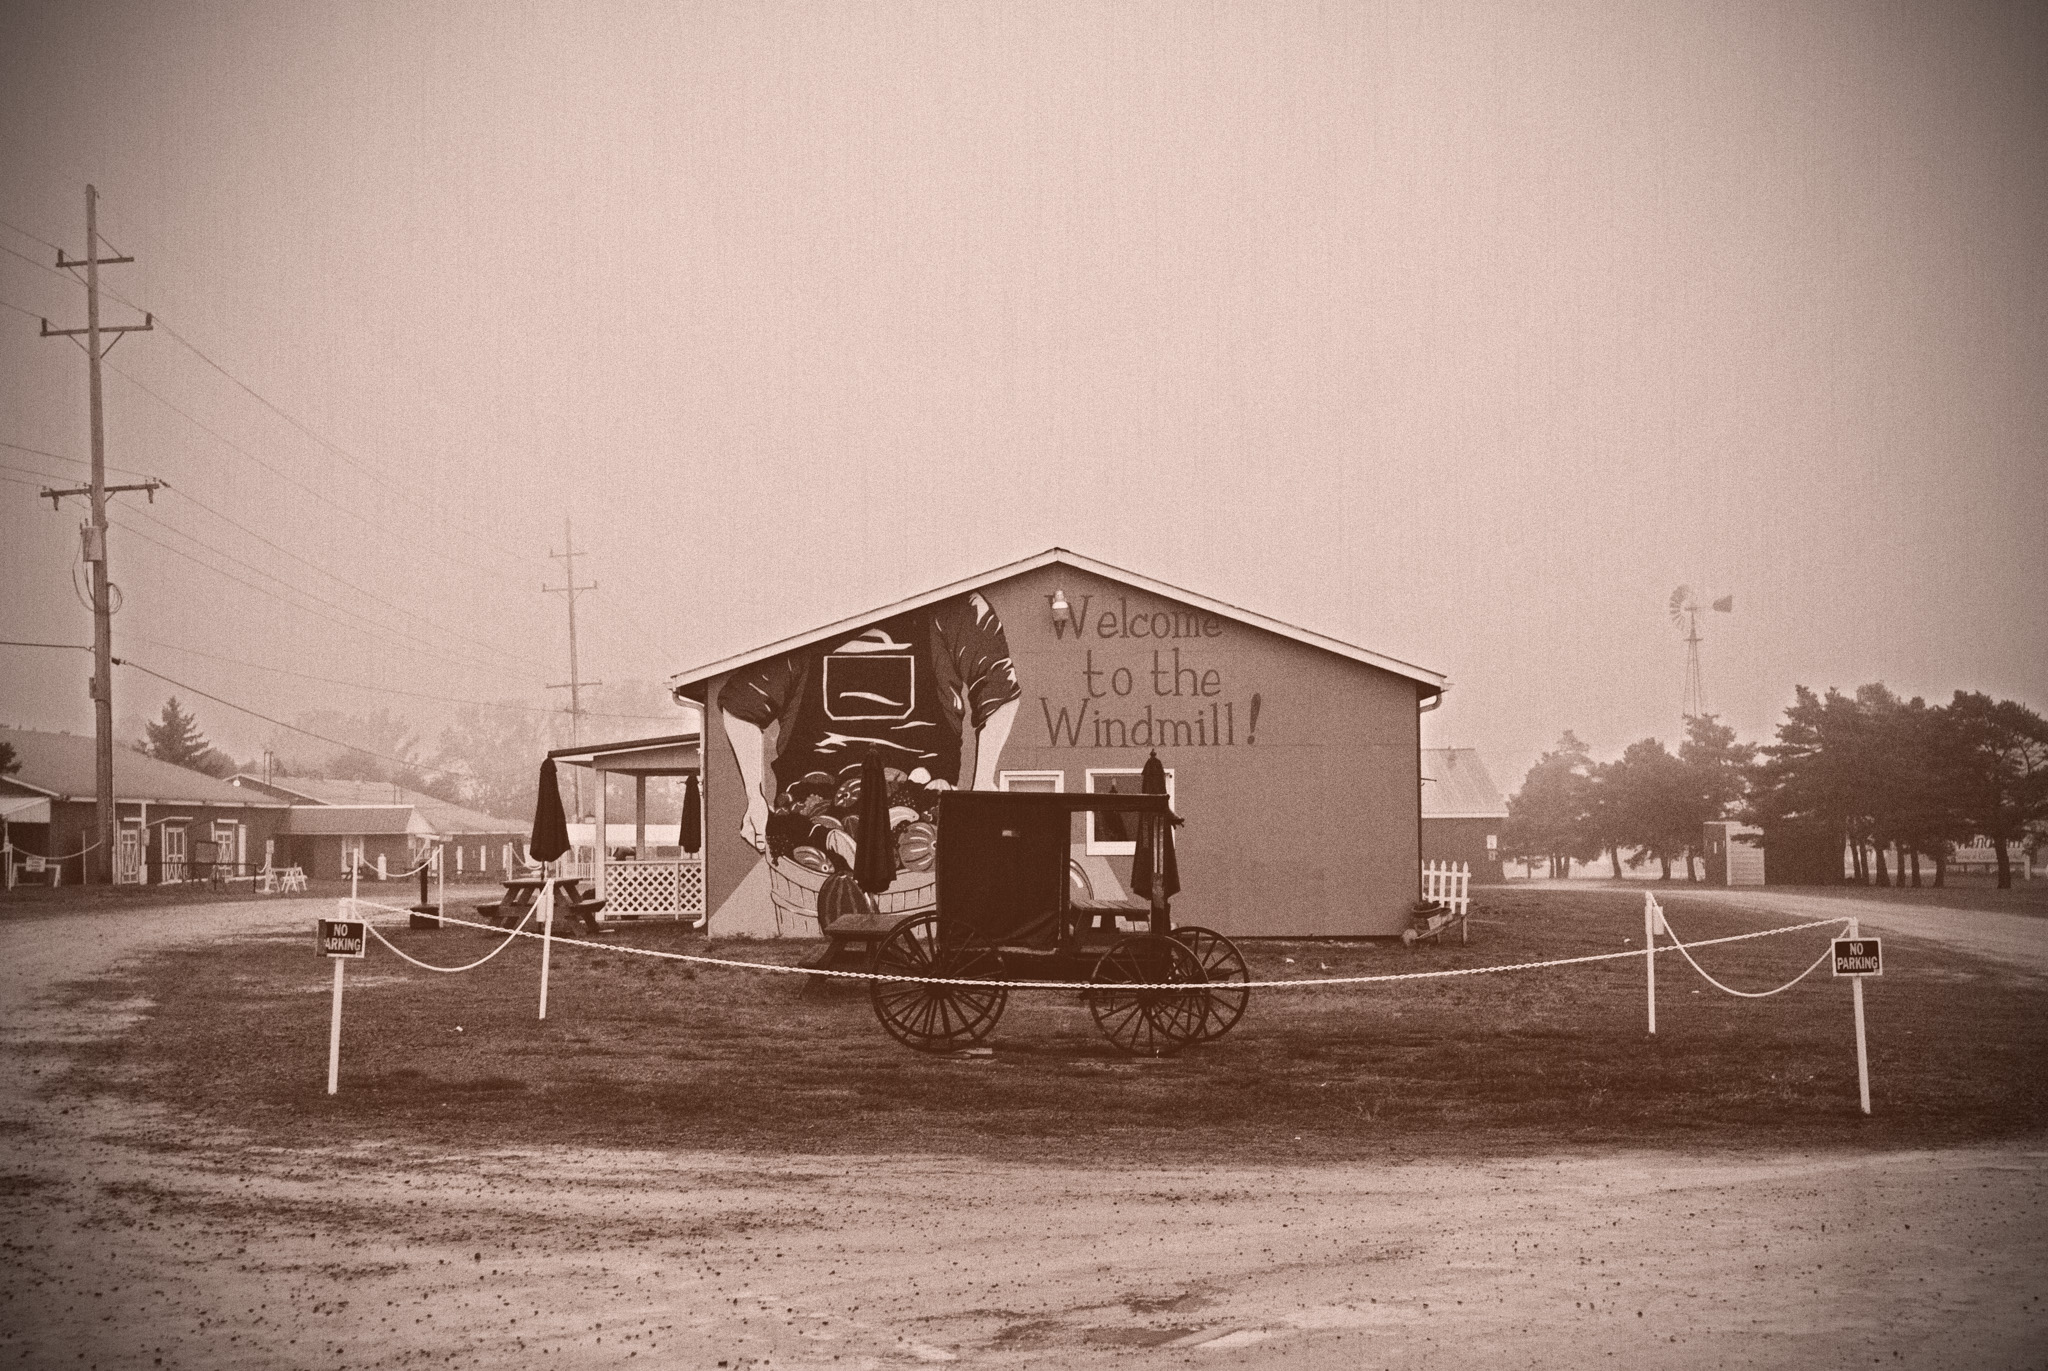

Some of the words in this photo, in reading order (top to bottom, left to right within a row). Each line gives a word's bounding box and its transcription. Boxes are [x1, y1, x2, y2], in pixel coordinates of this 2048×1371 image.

[1044, 594, 1223, 640] Welcome
[1082, 649, 1133, 698] to
[1150, 647, 1222, 697] the
[1039, 693, 1262, 747] Windmill!
[333, 923, 349, 937] NO
[324, 937, 361, 951] ARKING
[1849, 942, 1864, 956] NO
[1836, 956, 1878, 970] PARKING
